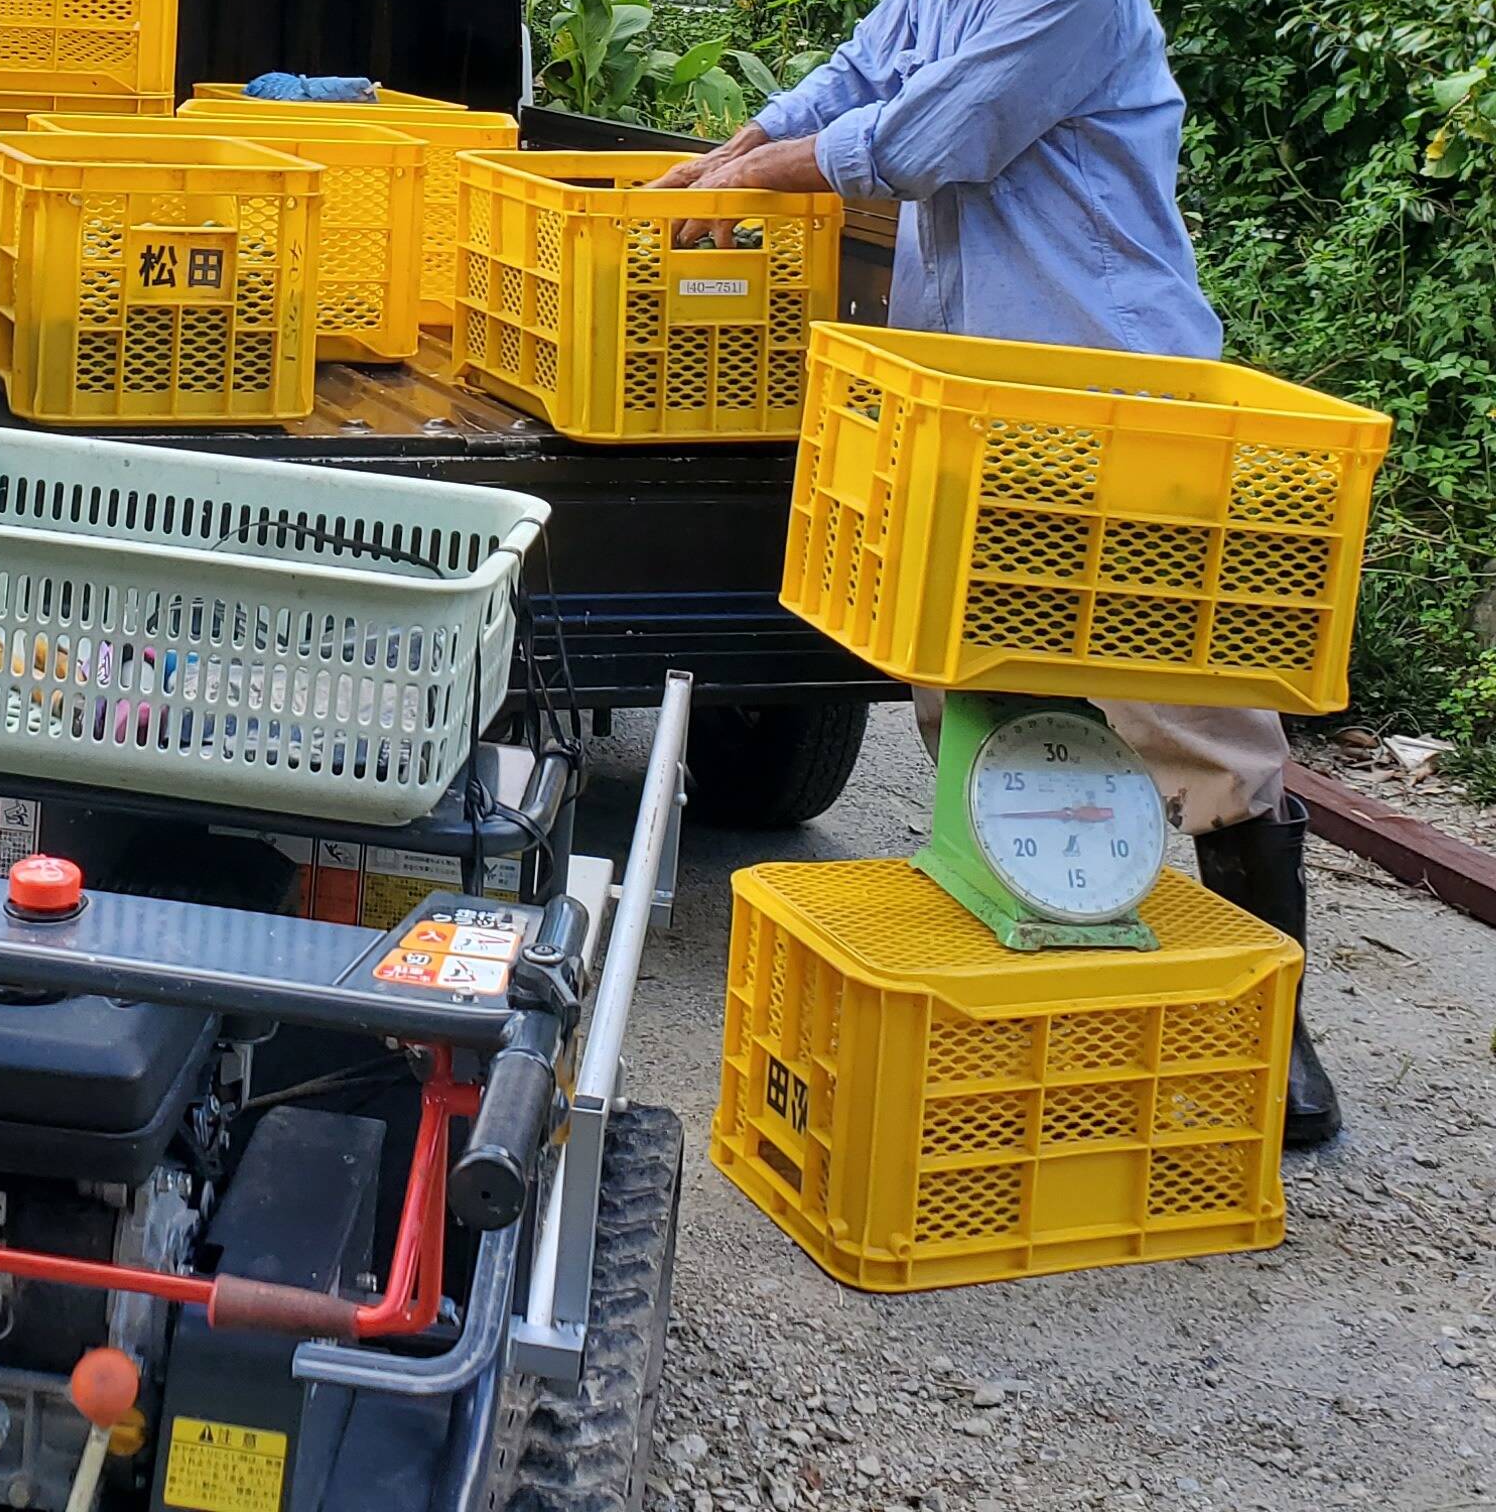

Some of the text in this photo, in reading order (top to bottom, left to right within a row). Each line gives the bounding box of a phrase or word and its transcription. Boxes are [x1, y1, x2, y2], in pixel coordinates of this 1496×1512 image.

[139, 244, 225, 289] 松田
[1043, 743, 1068, 763] 30
[1003, 772, 1025, 791] 25
[1105, 775, 1117, 793] 5
[1013, 838, 1038, 858] 20
[1110, 839, 1129, 858] 10
[1067, 869, 1087, 889] 15
